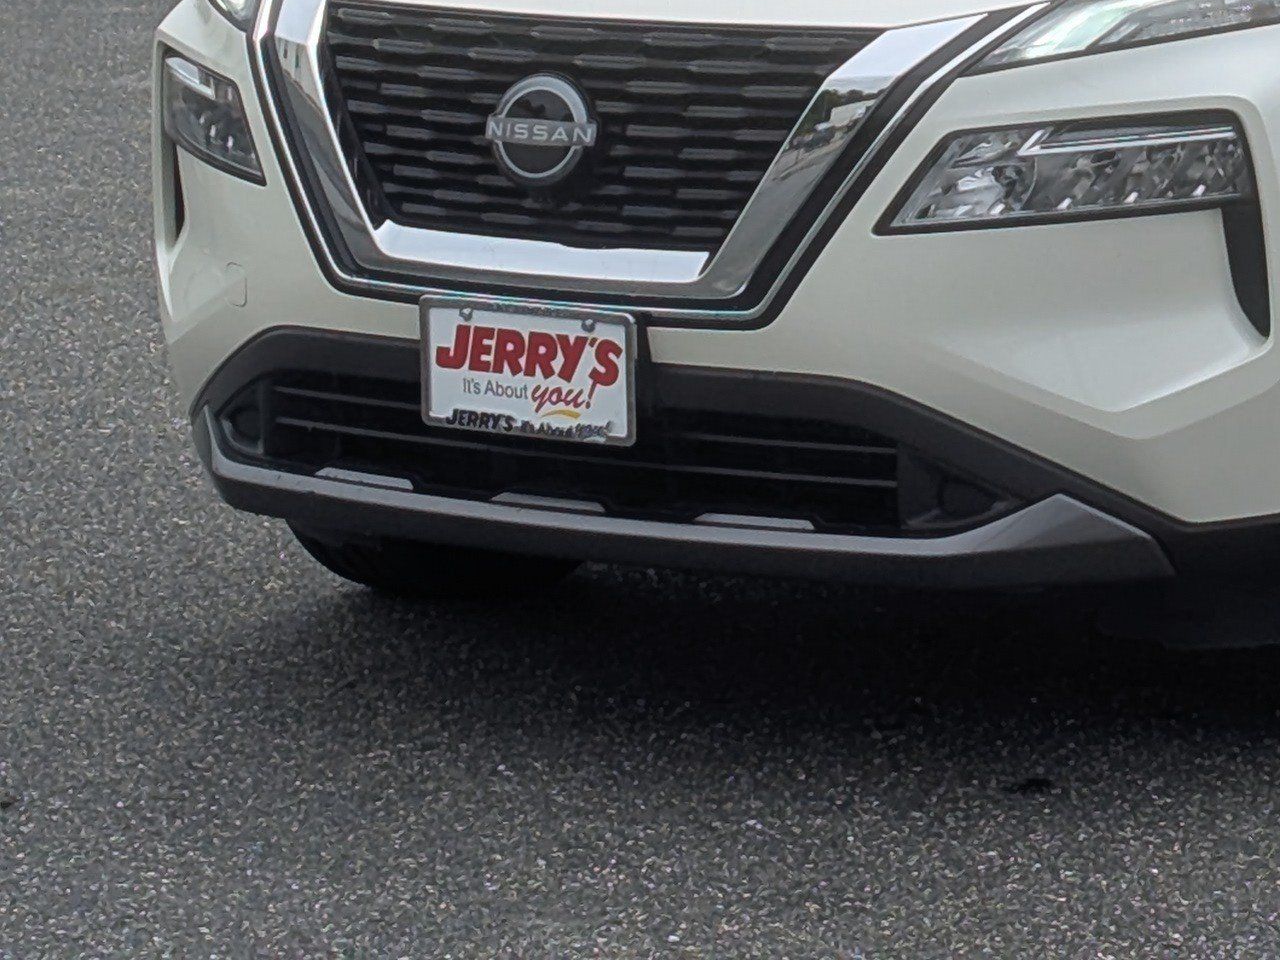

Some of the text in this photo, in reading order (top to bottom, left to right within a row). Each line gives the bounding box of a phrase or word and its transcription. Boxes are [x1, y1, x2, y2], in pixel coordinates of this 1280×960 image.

[488, 121, 593, 143] NISSAN
[435, 323, 624, 387] JERRY'S
[462, 377, 598, 413] It's About you!
[445, 408, 518, 432] JERRY'S
